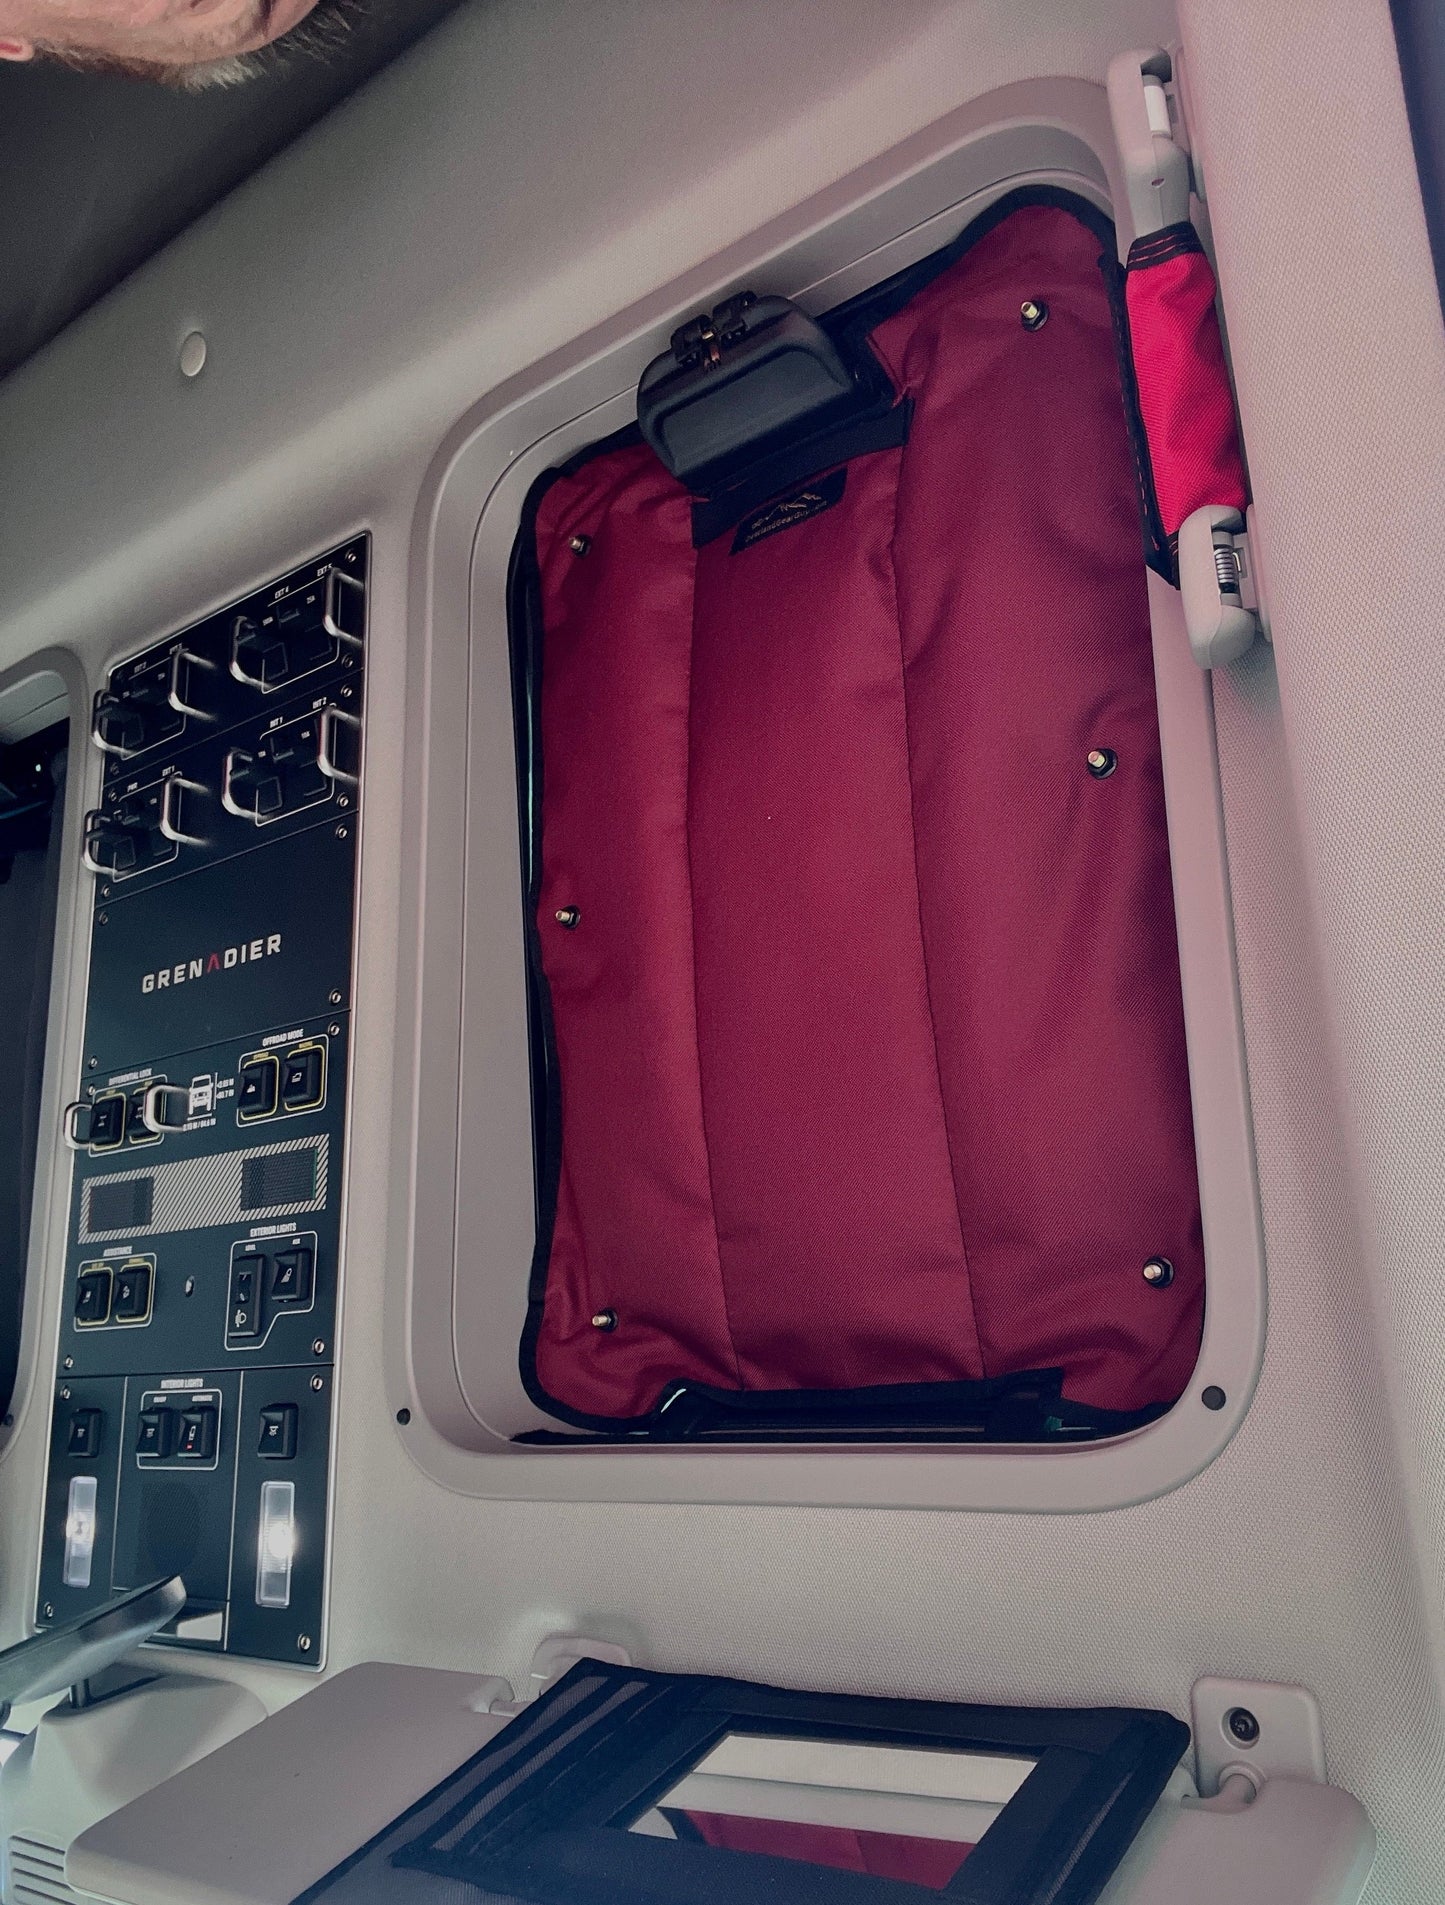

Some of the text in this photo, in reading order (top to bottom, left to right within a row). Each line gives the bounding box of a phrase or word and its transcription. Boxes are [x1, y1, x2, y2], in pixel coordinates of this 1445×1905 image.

[142, 933, 282, 994] GRENADIER
[249, 1222, 297, 1238] EXTERIOR LIGHTS
